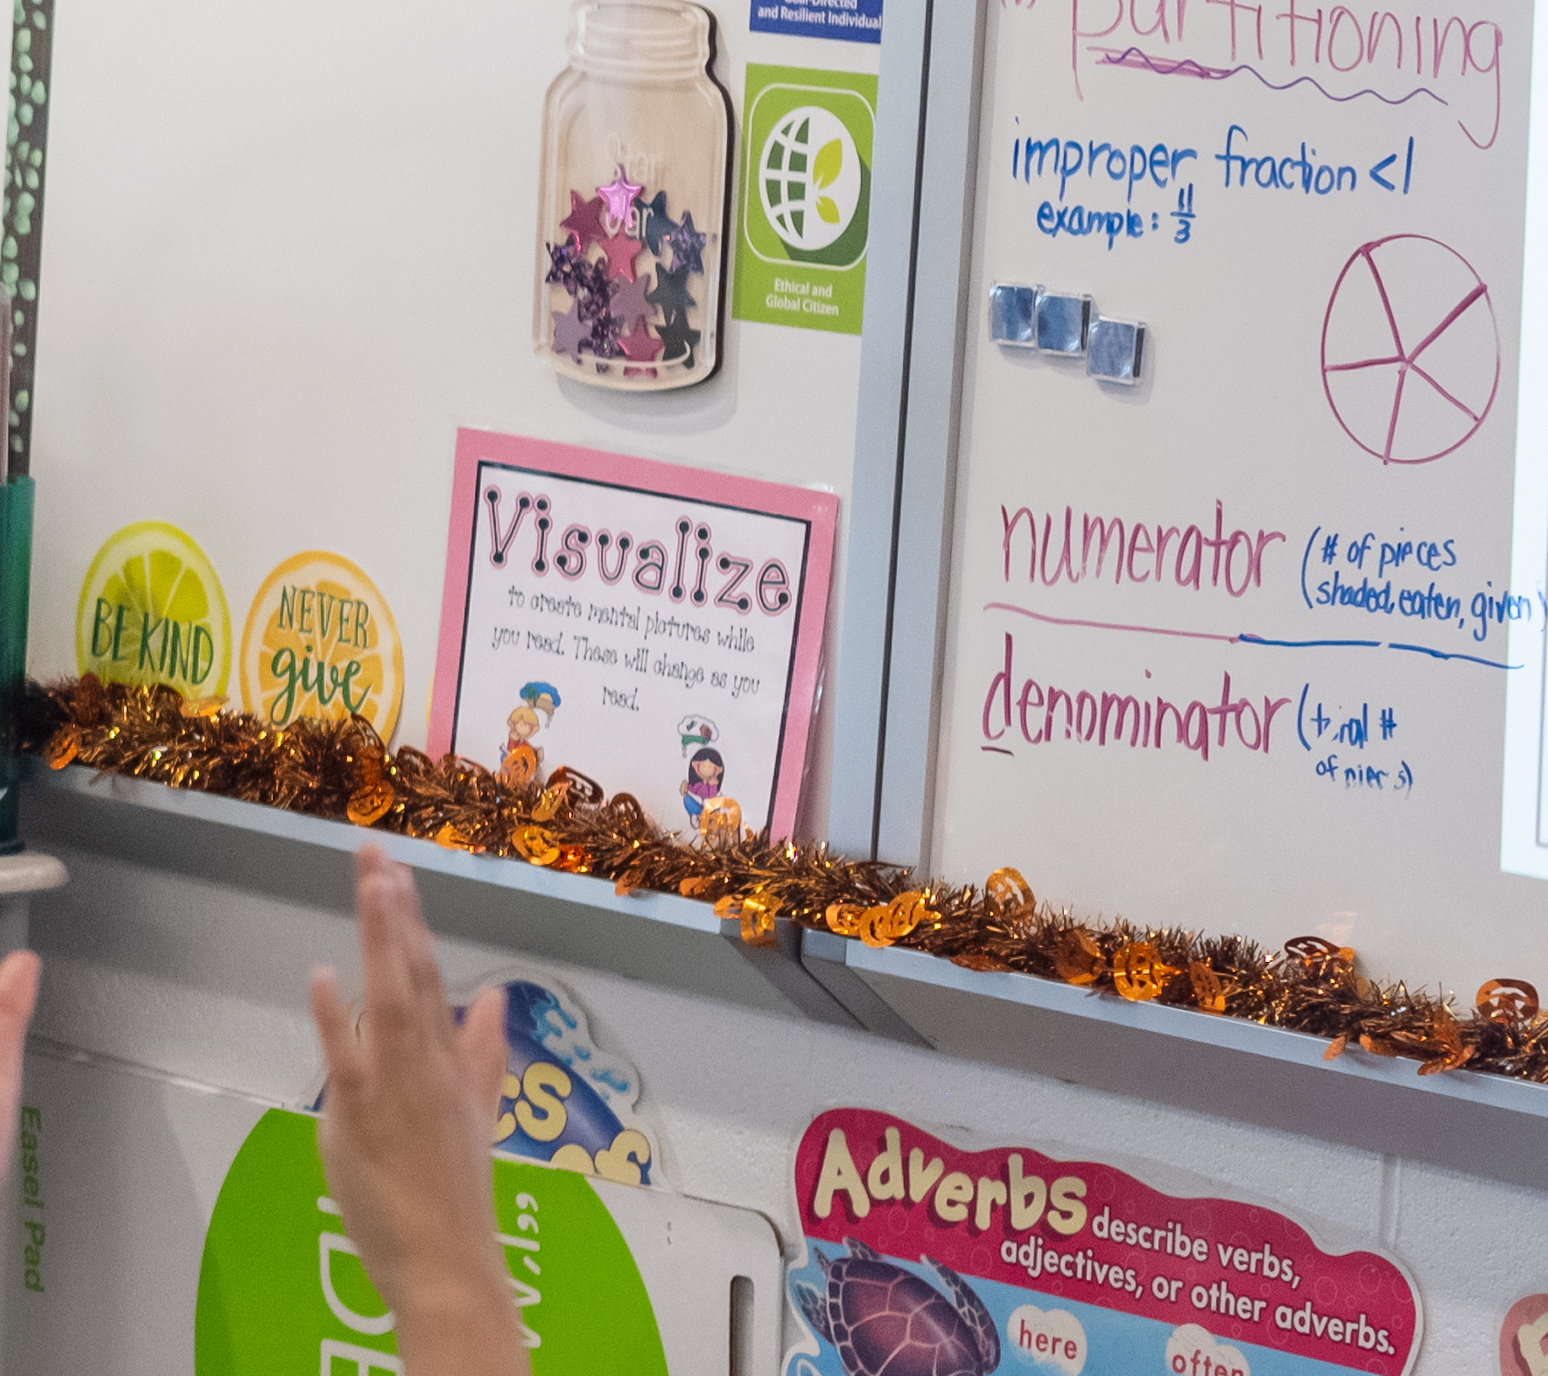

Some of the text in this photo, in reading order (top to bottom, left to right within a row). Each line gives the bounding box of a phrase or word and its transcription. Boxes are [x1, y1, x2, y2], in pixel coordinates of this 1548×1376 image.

[758, 5, 884, 30] and Resilient Individual
[1011, 118, 1357, 203] improper fraction
[765, 294, 840, 316] Global Citizen
[774, 277, 833, 298] Ethical and
[484, 484, 794, 617] Visualize
[1002, 498, 1286, 598] numerator
[1347, 532, 1376, 567] of
[91, 598, 215, 688] BE KIND
[277, 584, 371, 650] NEVER
[508, 585, 756, 653] to create mental pictures while
[270, 636, 370, 729] give
[491, 626, 761, 699] you read. These will change as you
[602, 685, 641, 712] read.
[982, 631, 1293, 762] denominator
[1314, 755, 1339, 780] of
[21, 1105, 45, 1293] Easel Pad
[812, 1126, 1302, 1290] Adverbs describe verbs,
[1000, 1236, 1397, 1356] adjectives, or other adverbs.
[1017, 1317, 1079, 1361] here
